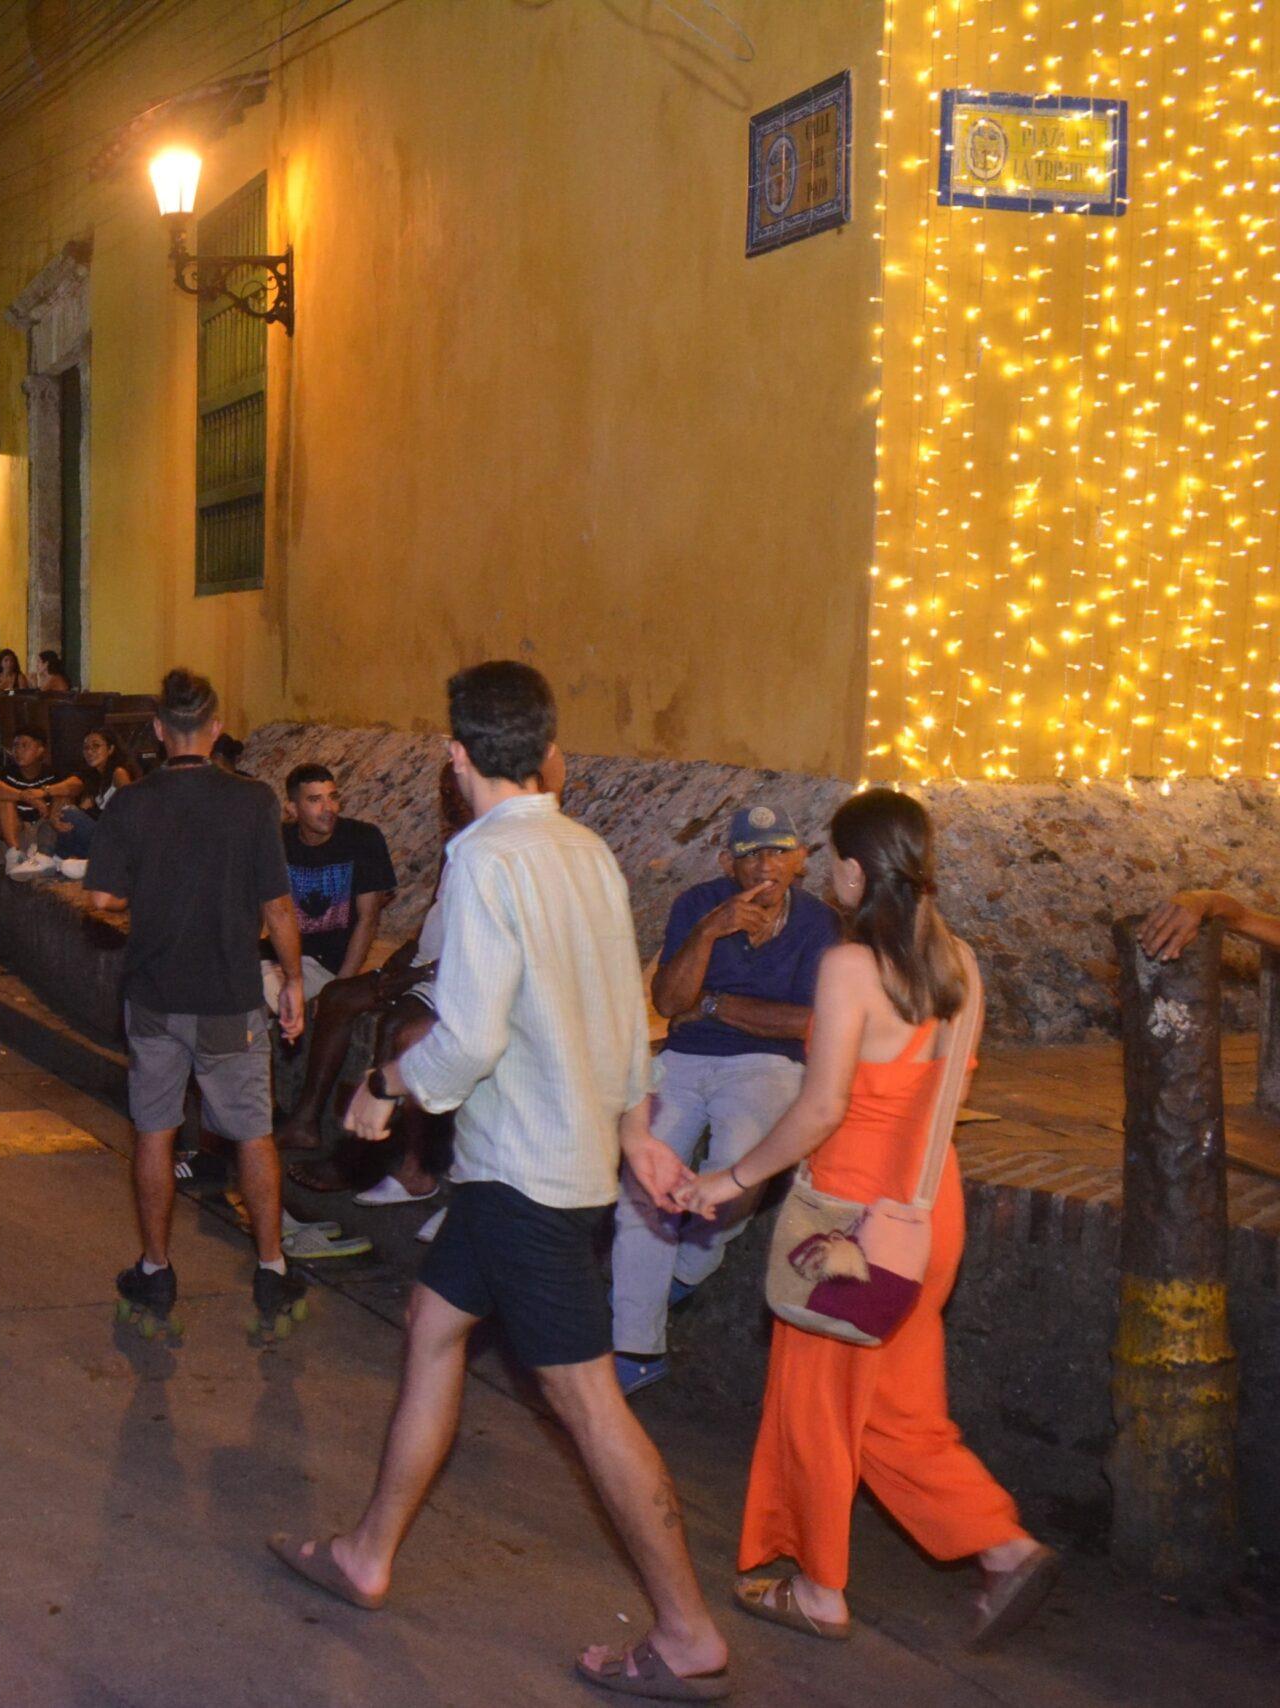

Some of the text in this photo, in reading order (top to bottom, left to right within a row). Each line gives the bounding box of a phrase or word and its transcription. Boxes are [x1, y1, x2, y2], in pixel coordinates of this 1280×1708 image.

[805, 113, 831, 140] CALLE
[1021, 127, 1066, 148] PLAZA
[1031, 157, 1099, 184] TRINID
